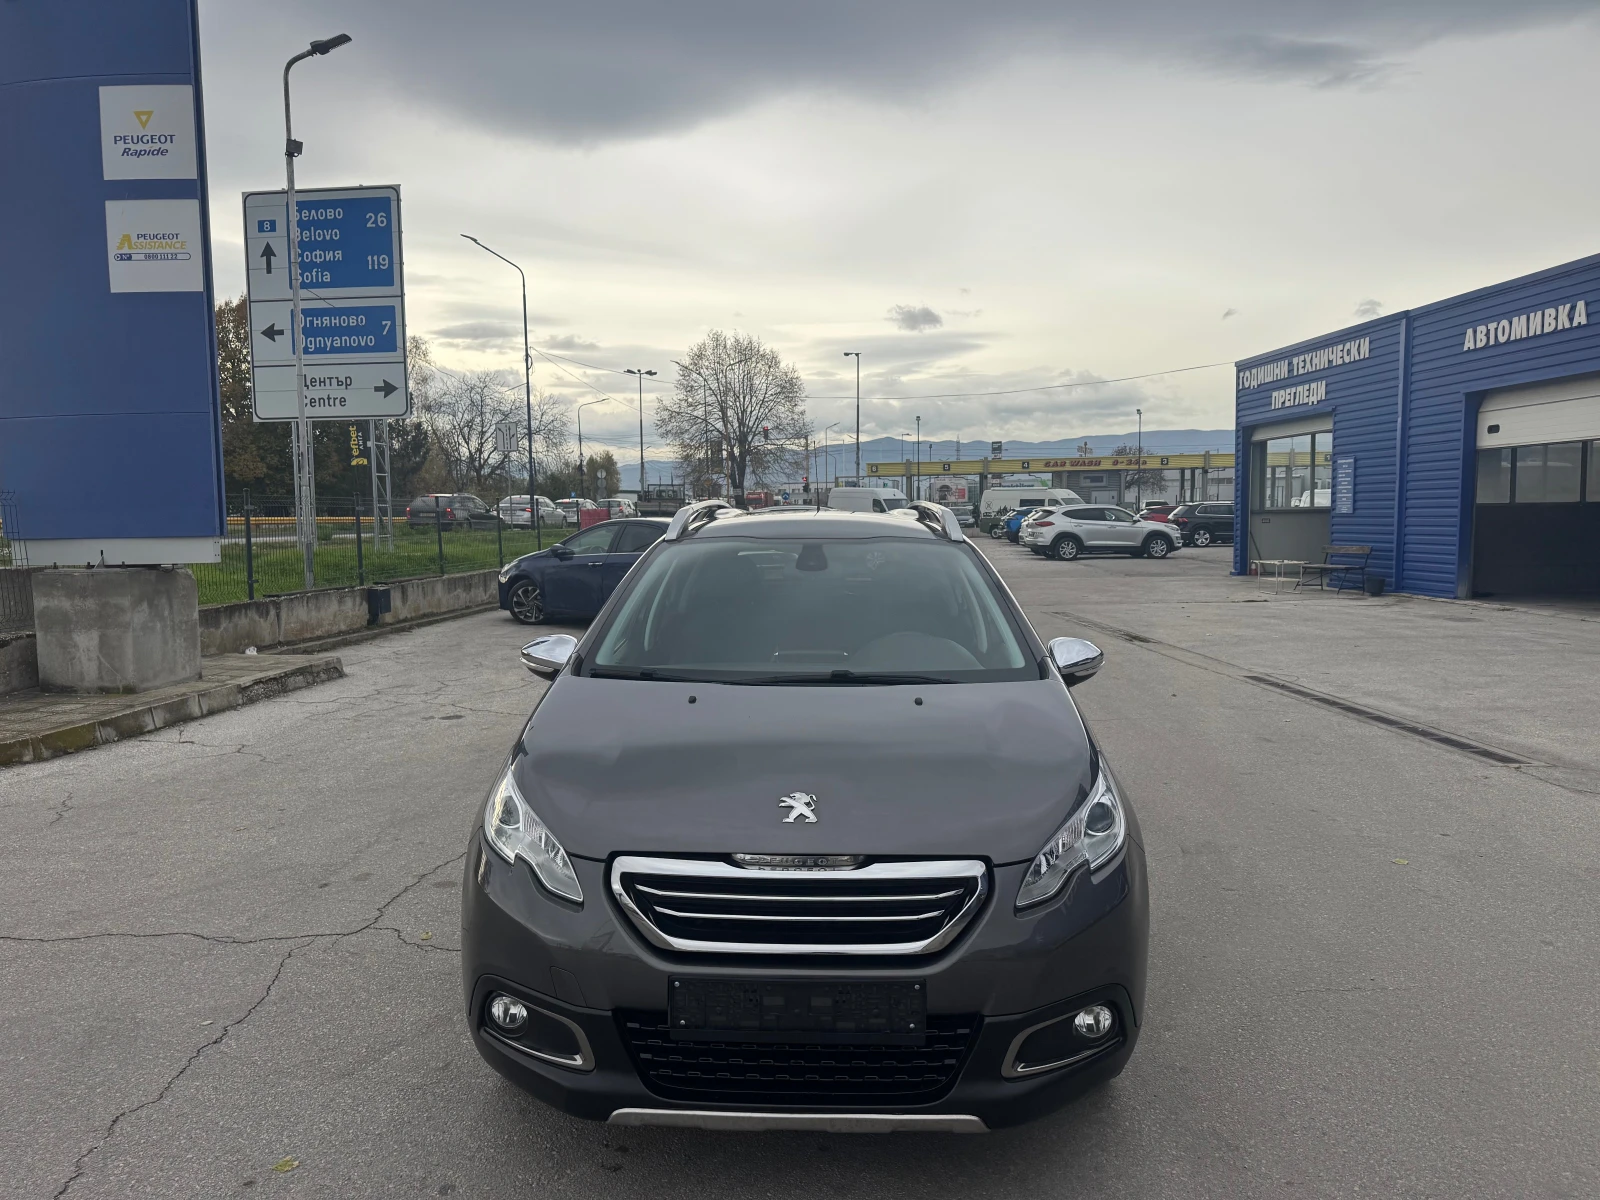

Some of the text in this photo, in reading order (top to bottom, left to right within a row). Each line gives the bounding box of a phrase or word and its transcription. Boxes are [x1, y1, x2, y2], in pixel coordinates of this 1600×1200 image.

[113, 134, 176, 145] PEUGEOT
[121, 147, 169, 158] Rapide
[263, 221, 271, 231] 8
[366, 212, 387, 228] 26
[116, 234, 187, 250] ASSISTANCE
[367, 255, 389, 270] 119
[382, 321, 391, 335] 7
[1464, 300, 1588, 351] АВТОМИВКА
[1239, 337, 1370, 389] ГОДИШНИ ТЕХНИЧЕСКИ
[304, 394, 347, 408] entre
[1272, 380, 1326, 410] ПРЕГЛЕДИ
[349, 425, 359, 456] efbet
[1070, 459, 1102, 467] WASH
